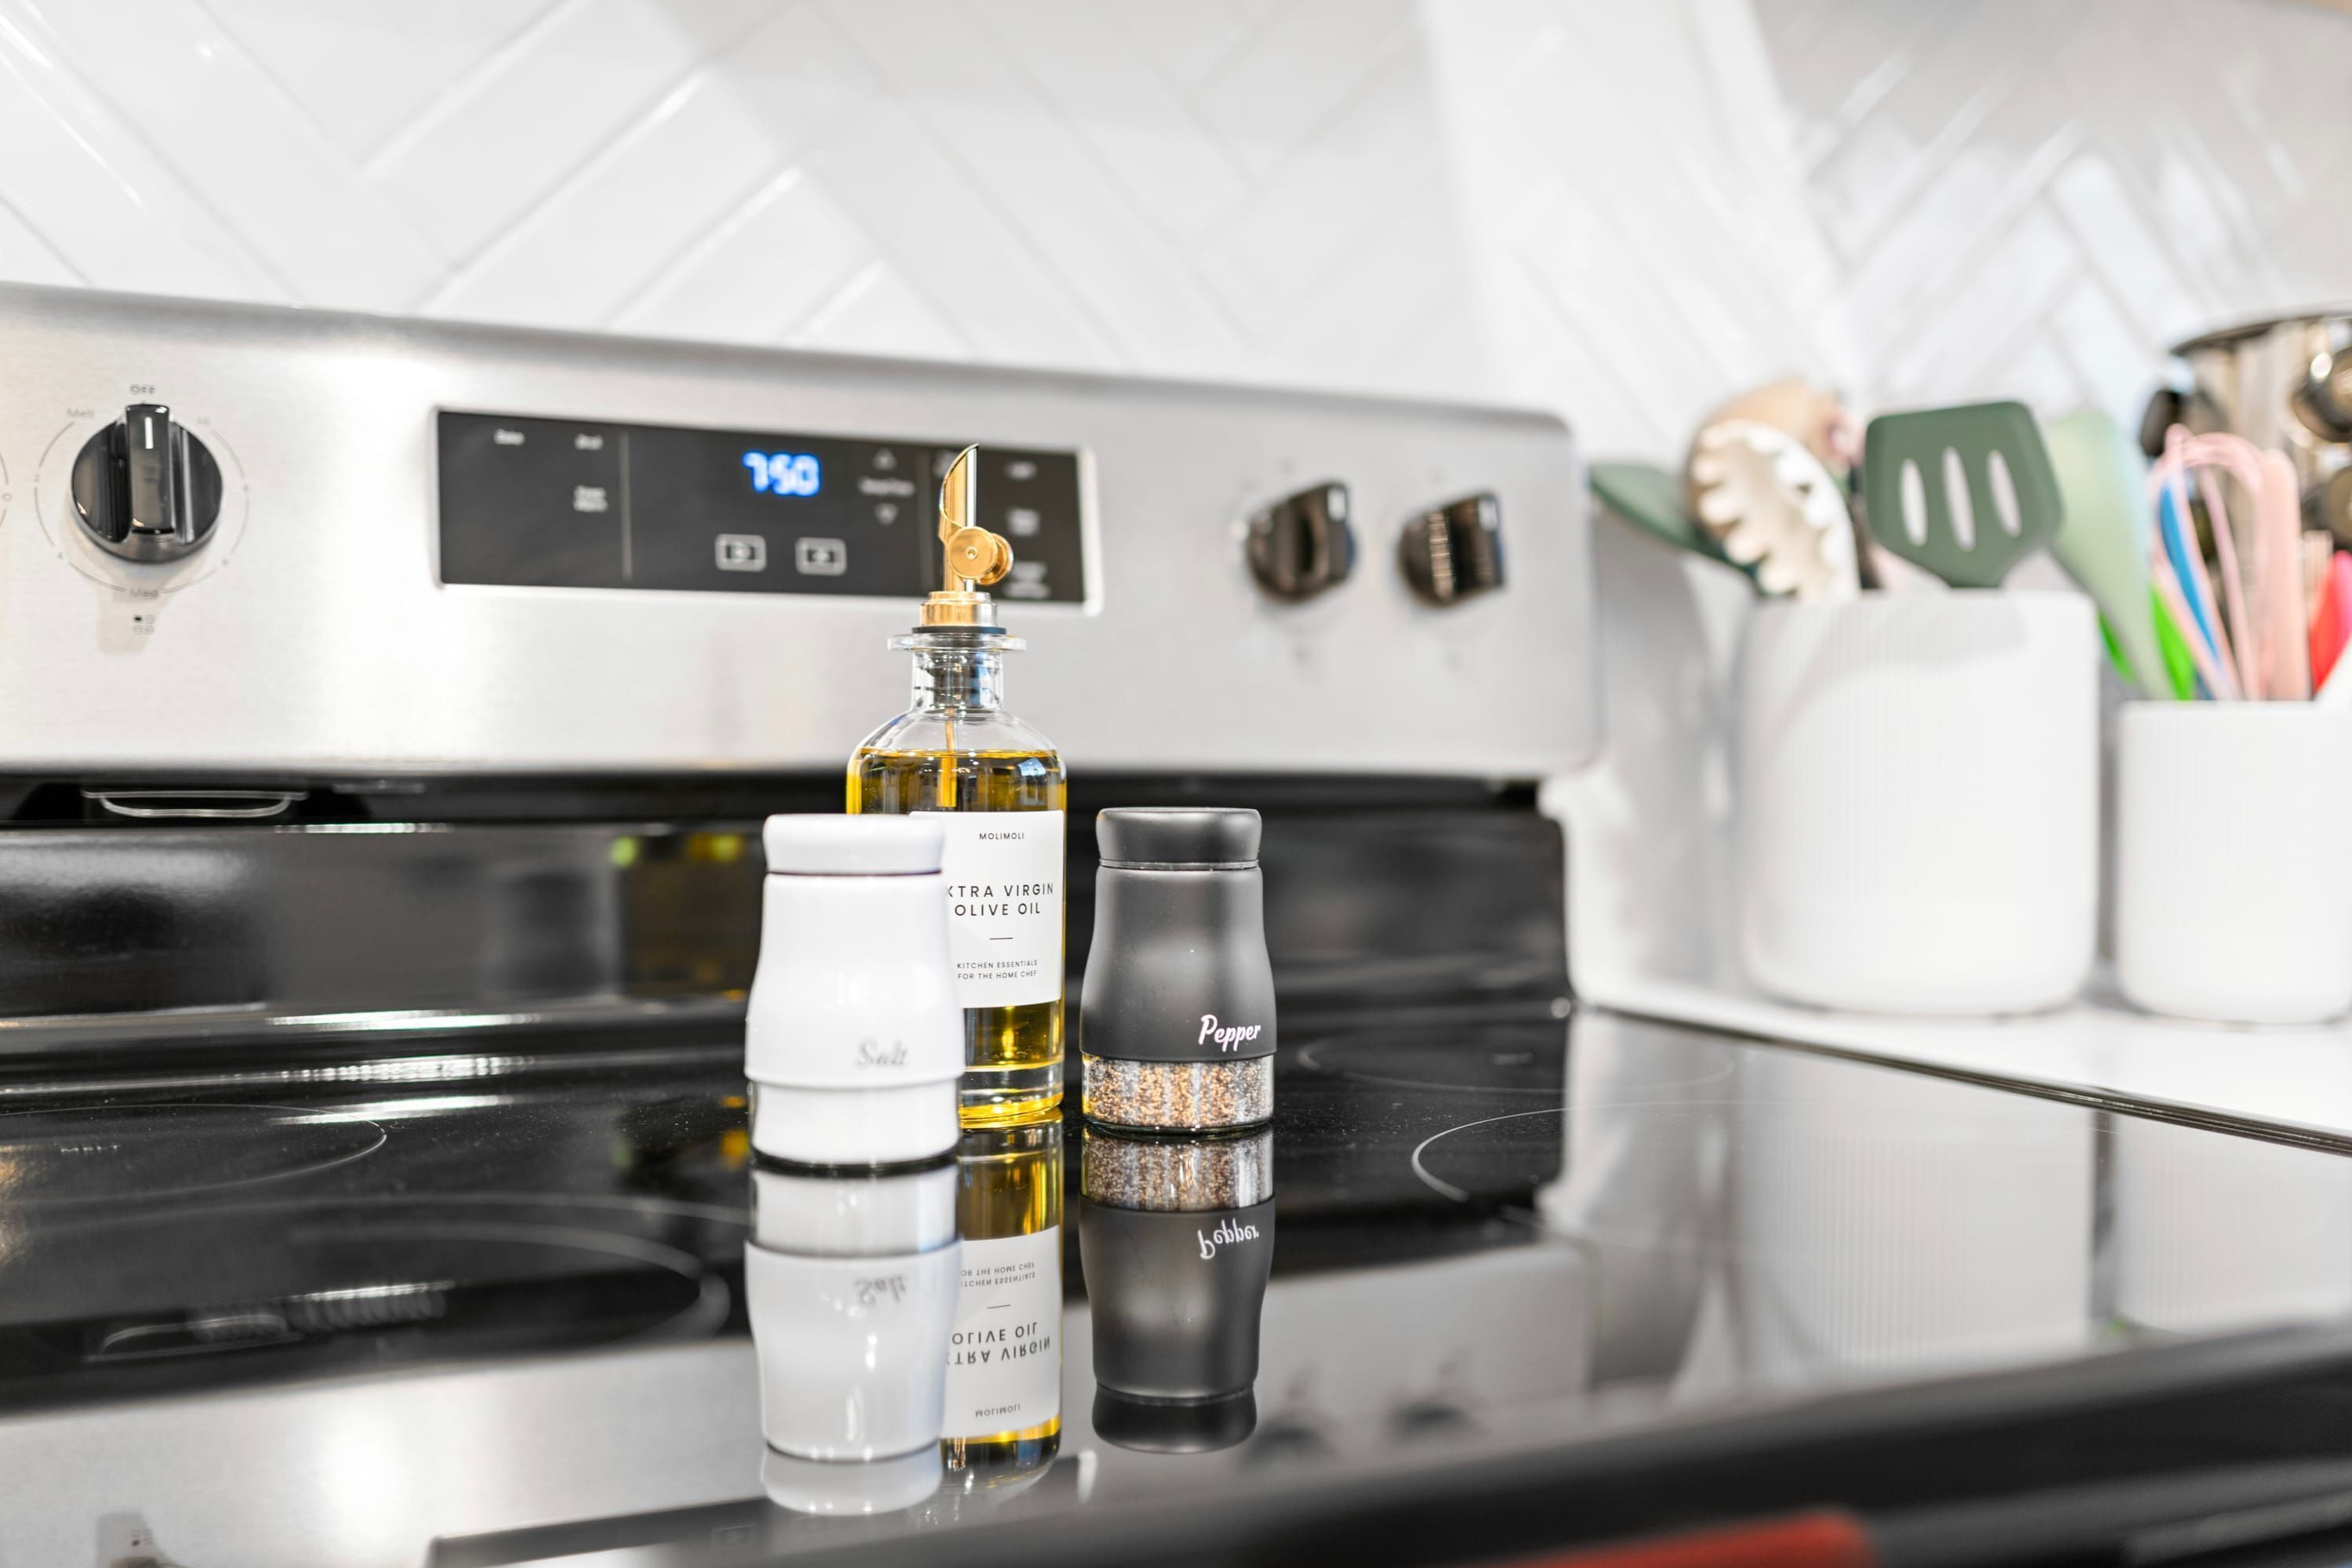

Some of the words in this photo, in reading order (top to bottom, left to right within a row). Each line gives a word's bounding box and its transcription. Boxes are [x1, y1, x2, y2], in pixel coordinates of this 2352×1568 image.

[979, 832, 1025, 840] MOLIMOLI
[946, 885, 993, 898] XTRA
[1004, 883, 1054, 897] VIRGIN
[954, 903, 1009, 916] OLIVE
[1018, 902, 1040, 915] OIL
[996, 959, 1038, 968] ESSENTIALS
[1198, 1014, 1261, 1052] Pepper
[855, 1037, 909, 1068] Salt
